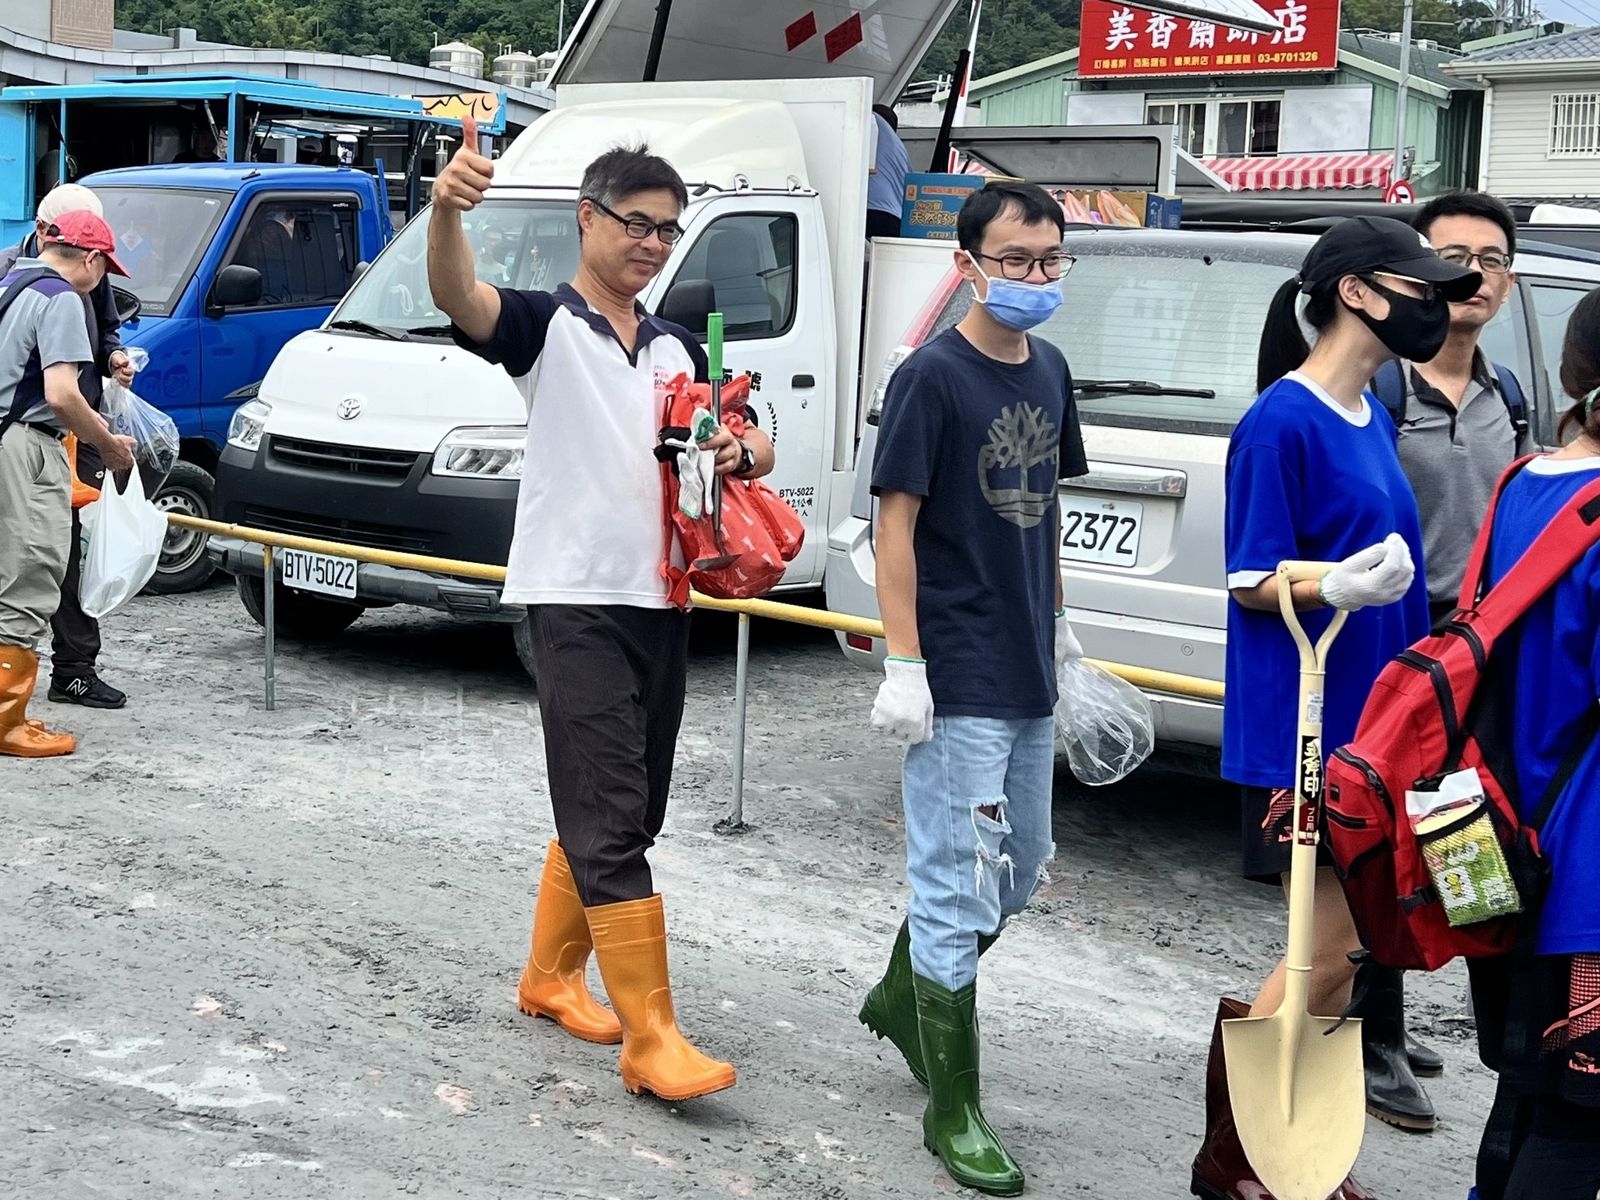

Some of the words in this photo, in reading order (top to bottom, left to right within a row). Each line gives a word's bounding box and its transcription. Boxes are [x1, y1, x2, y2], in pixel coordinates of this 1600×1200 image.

[1257, 51, 1318, 64] 03-8701326
[779, 486, 814, 498] BTV-5022
[284, 551, 355, 591] BTV-5022
